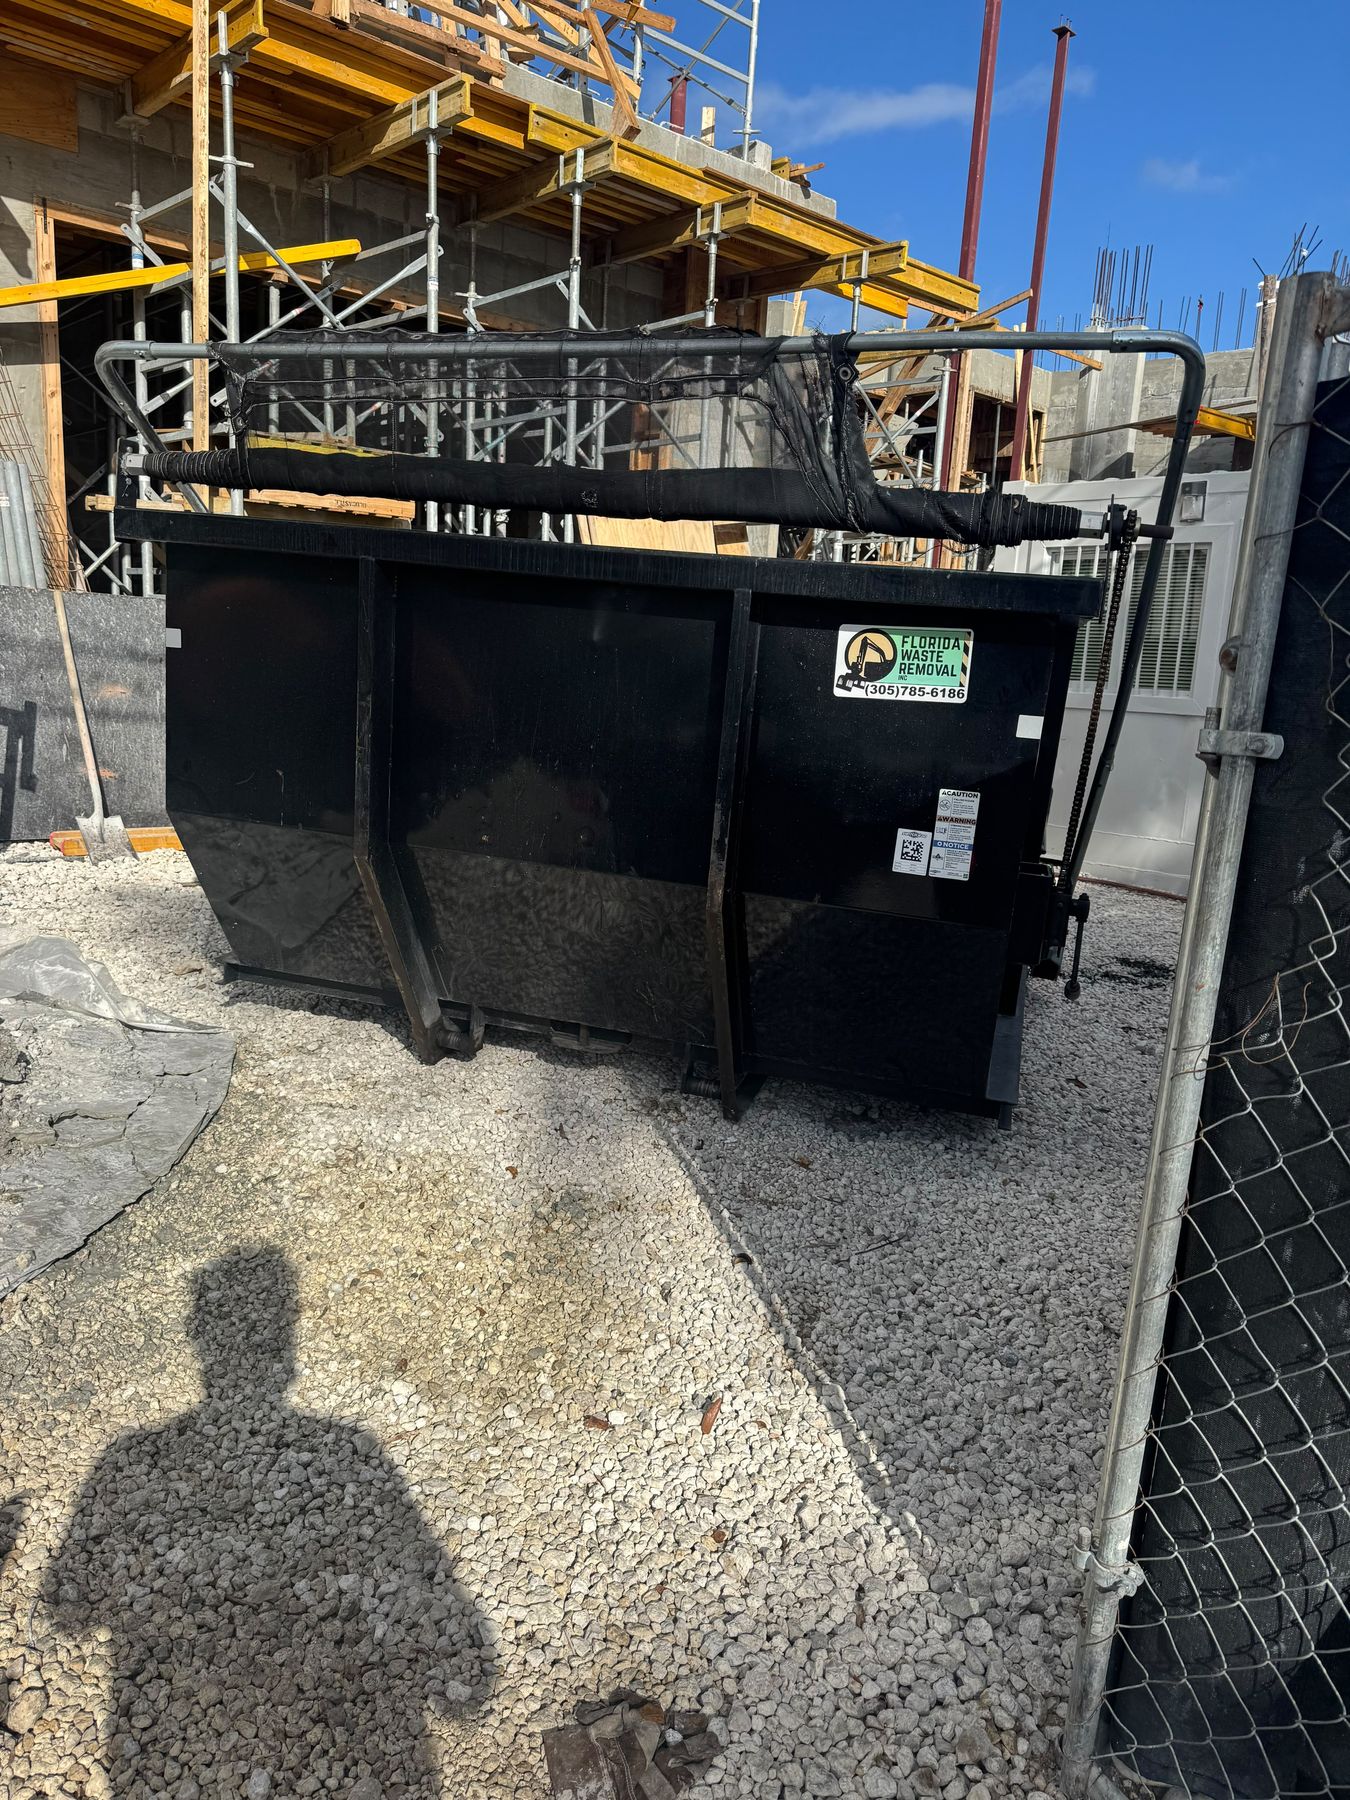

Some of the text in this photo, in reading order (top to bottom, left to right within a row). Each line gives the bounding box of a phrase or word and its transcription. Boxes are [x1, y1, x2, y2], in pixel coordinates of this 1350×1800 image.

[901, 635, 960, 650] FLORIDA
[901, 649, 944, 662] WASTE
[899, 663, 957, 676] REMOVAL
[865, 684, 965, 699] (305)785-6186
[943, 816, 976, 824] WARNING
